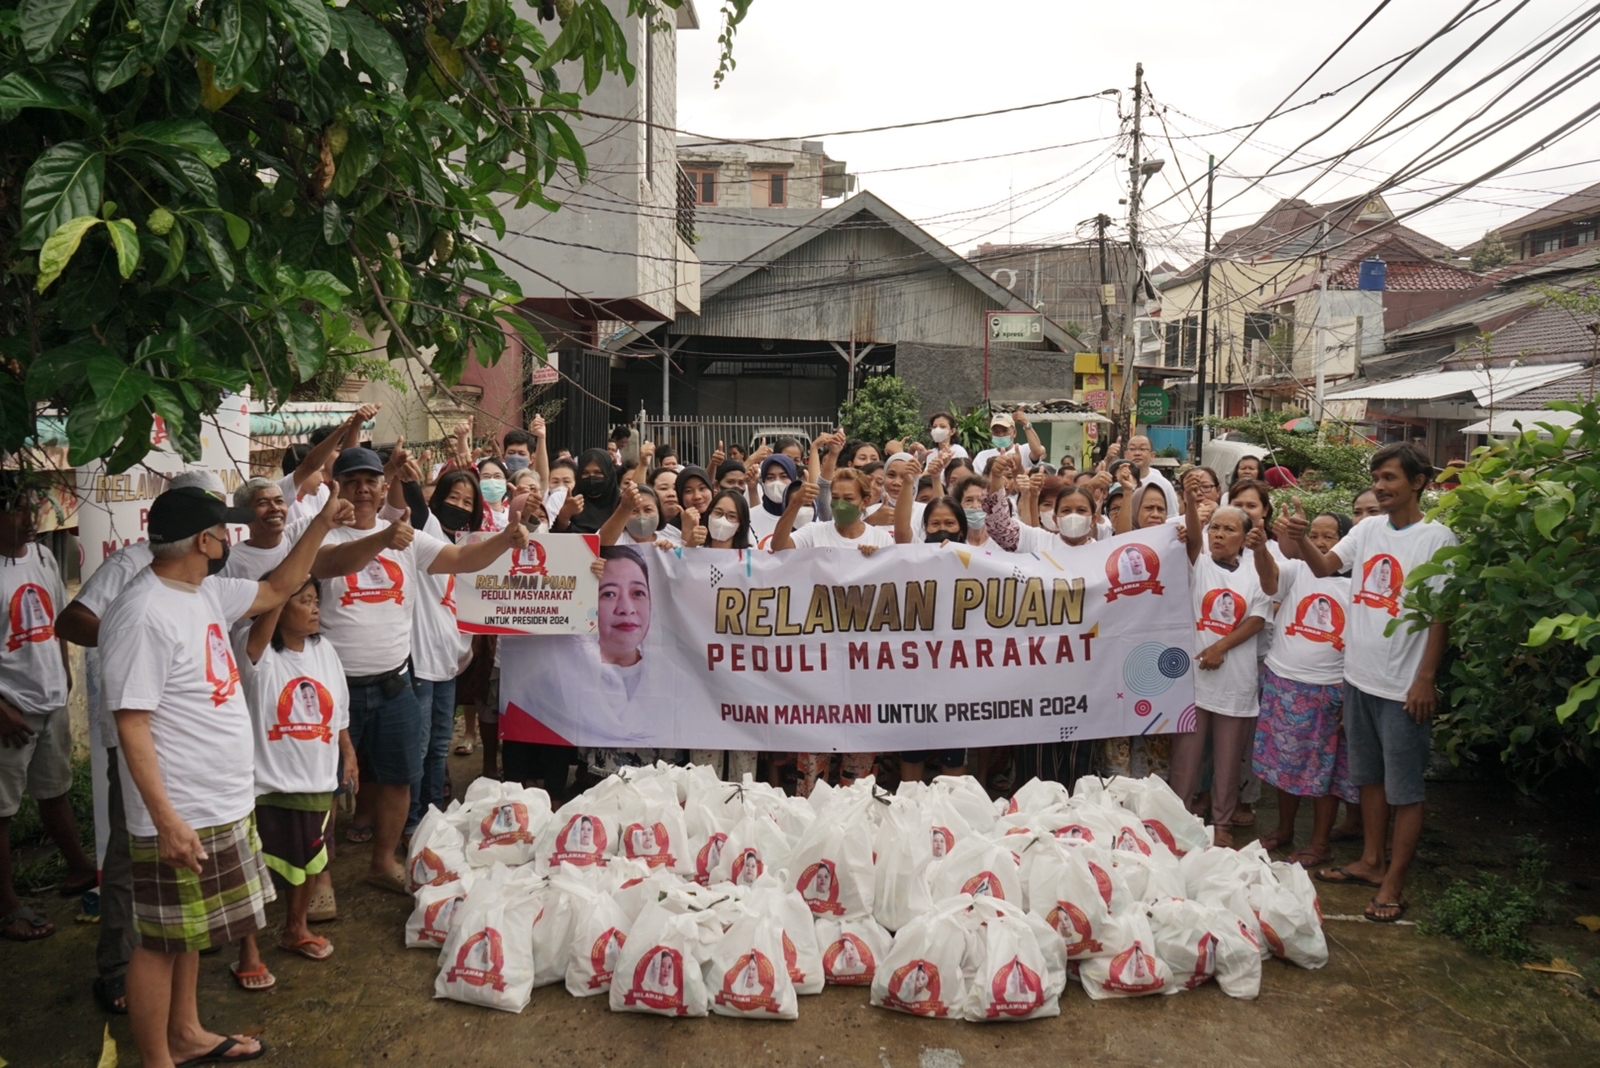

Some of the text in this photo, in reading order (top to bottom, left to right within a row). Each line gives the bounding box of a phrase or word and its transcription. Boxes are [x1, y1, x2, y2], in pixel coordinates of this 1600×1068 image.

[1139, 398, 1162, 407] Grab
[1138, 407, 1162, 416] Food
[475, 575, 577, 590] RELAWAN PUAN
[481, 590, 573, 600] PEDULI MASYARAKAT
[495, 606, 558, 615] PUAN MAHARANI
[715, 576, 1086, 637] RELAWAN PUAN
[484, 616, 569, 625] UNTUK PRESIDEN 2024
[707, 632, 1095, 672] PEDULI MASYARAKAT
[721, 695, 1088, 724] PUAN MAHARANI UNTUK PRESIDEN 2024
[455, 969, 485, 977] RELAWAN
[633, 992, 663, 1001] RELAWAN
[723, 994, 750, 1002] RELAWAN
